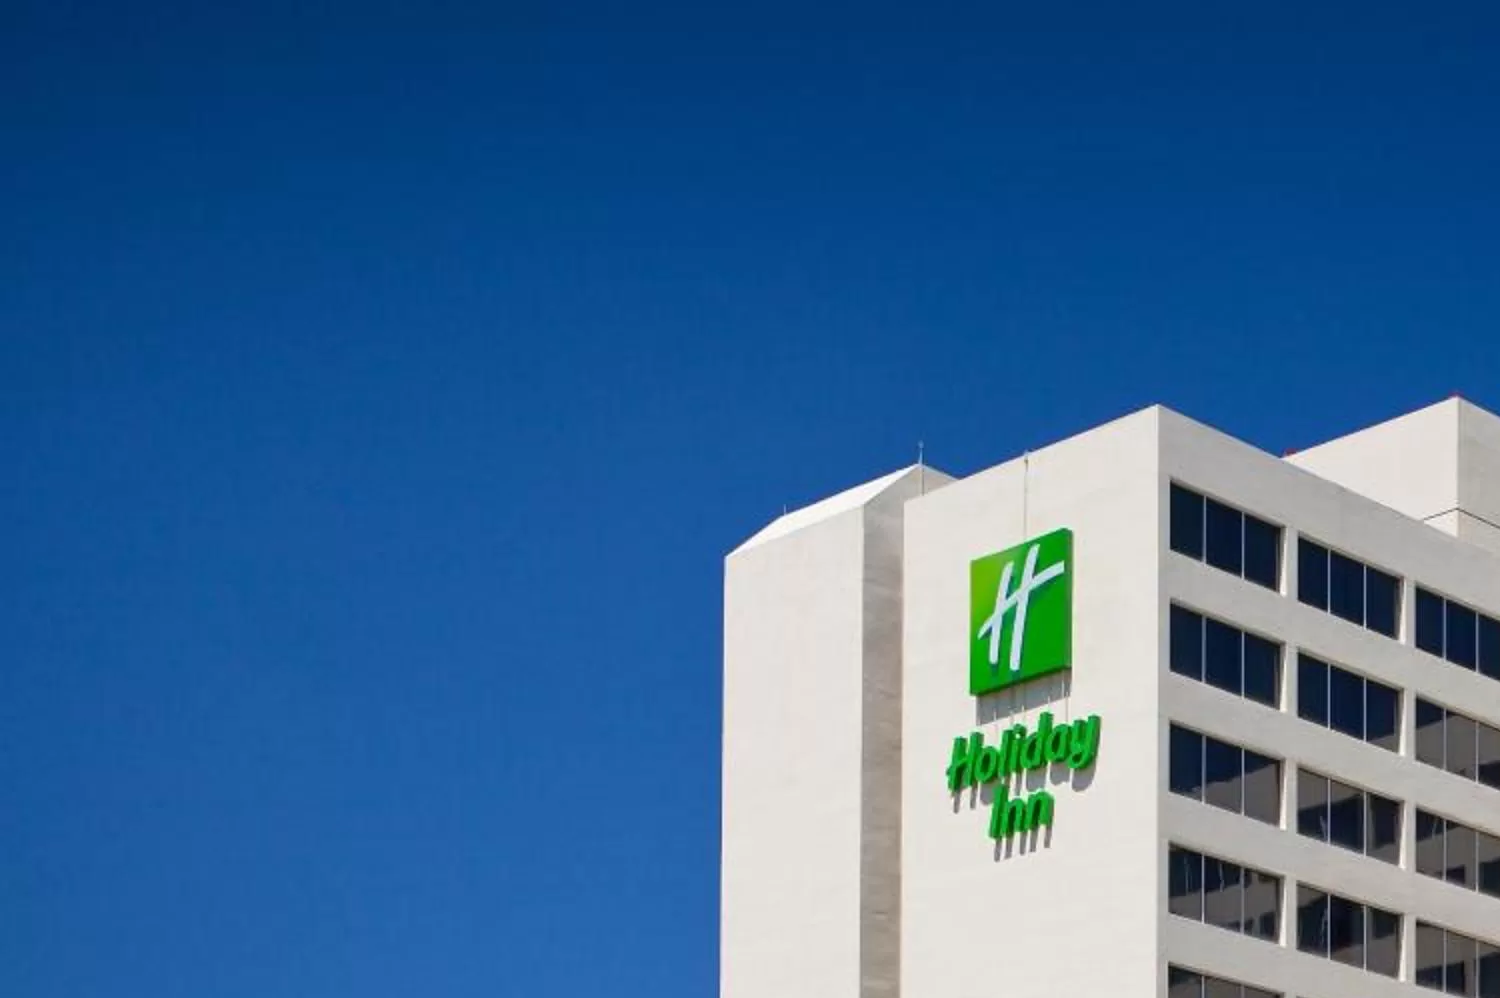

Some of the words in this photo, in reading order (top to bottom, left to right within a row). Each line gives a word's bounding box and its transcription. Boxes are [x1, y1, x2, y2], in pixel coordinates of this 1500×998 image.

[977, 544, 1065, 672] H
[946, 711, 1101, 793] Holiday
[988, 783, 1055, 839] Inn
